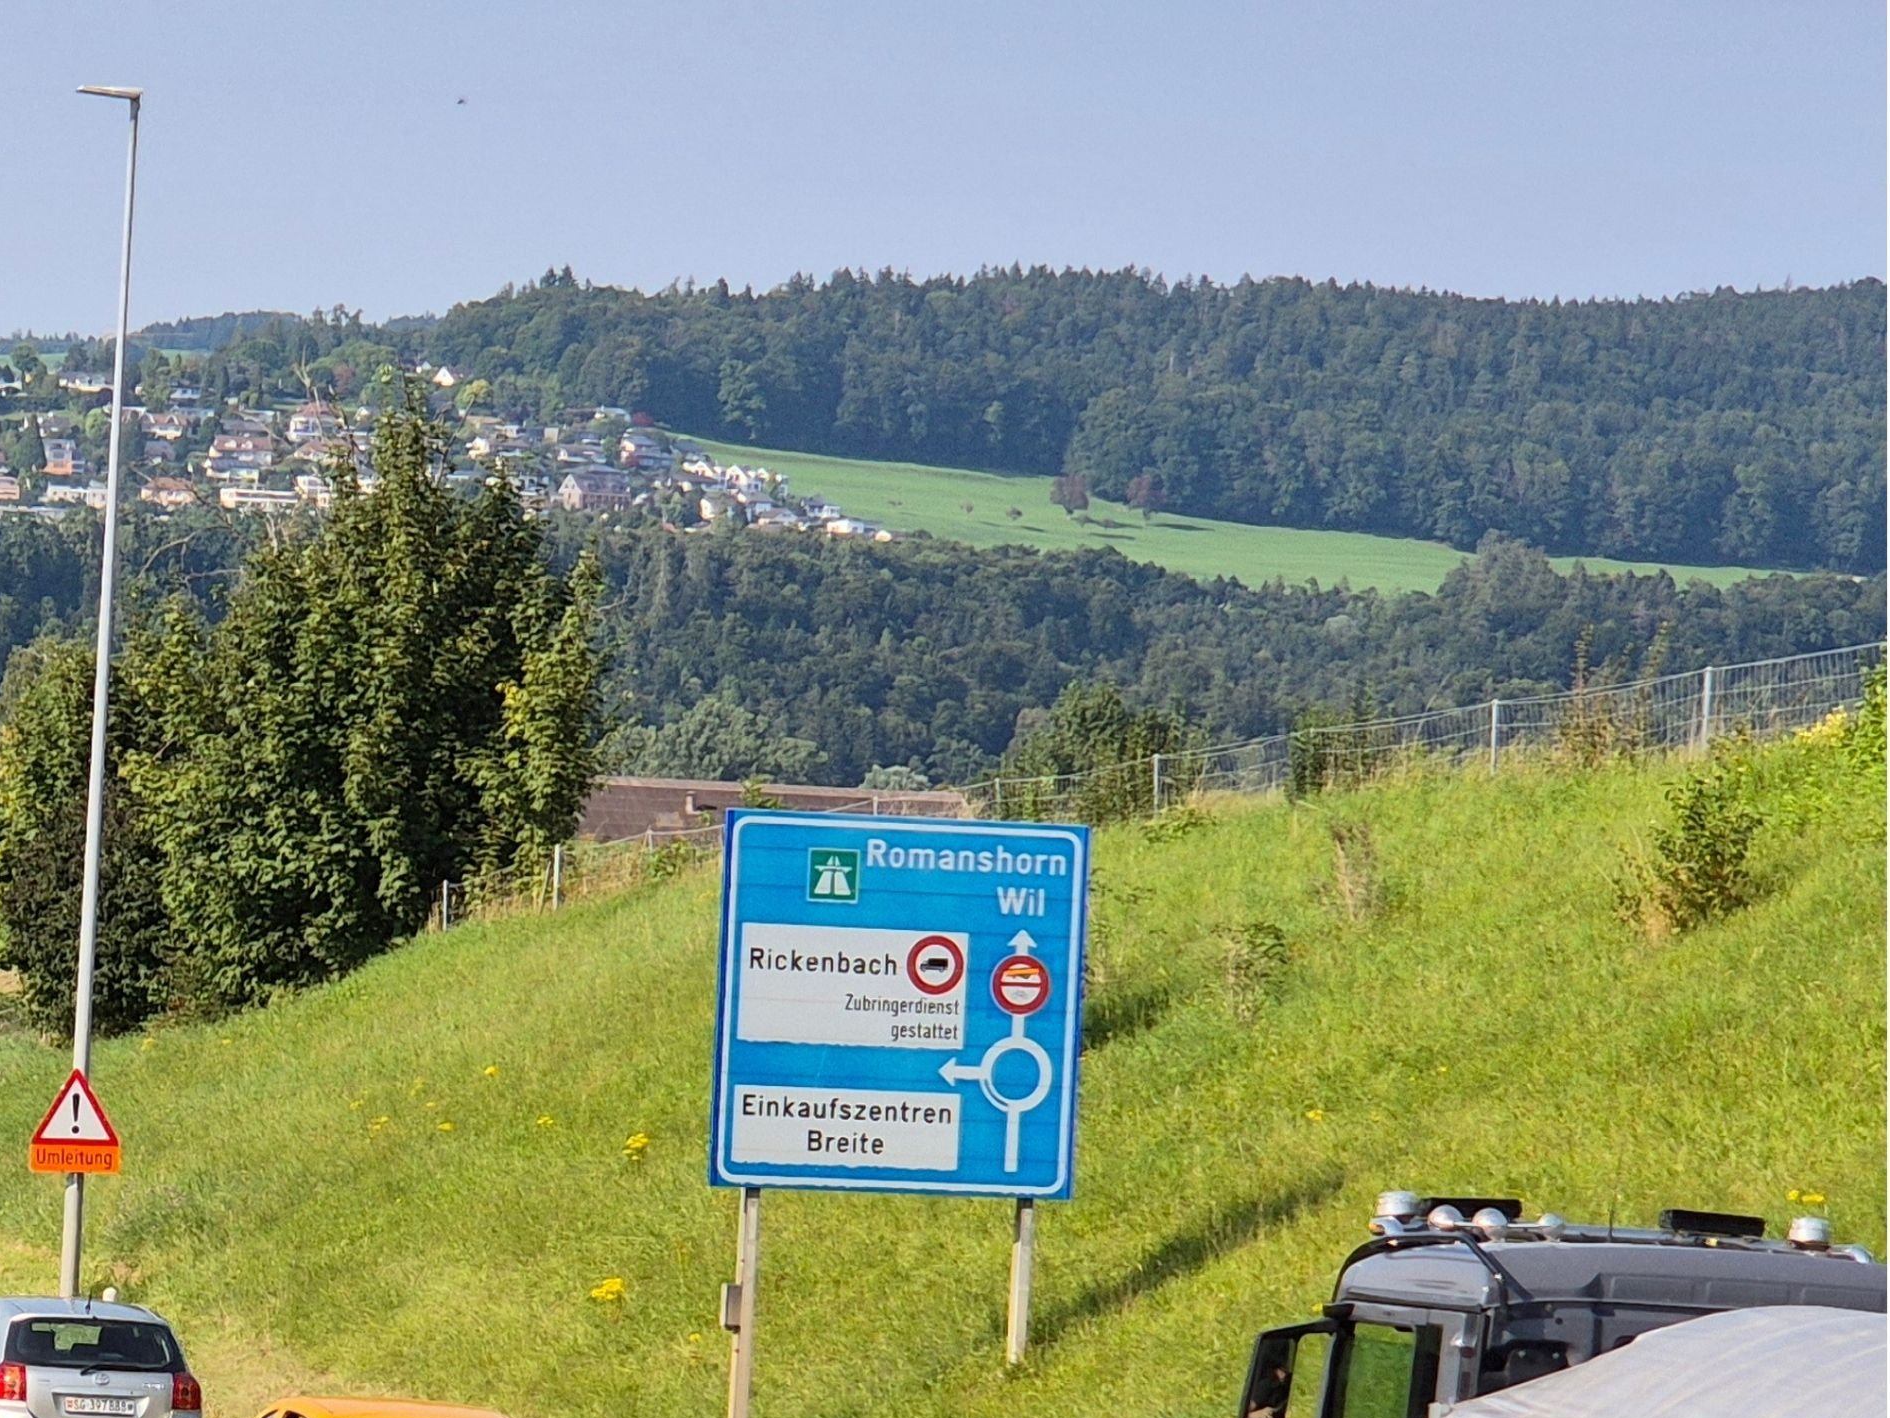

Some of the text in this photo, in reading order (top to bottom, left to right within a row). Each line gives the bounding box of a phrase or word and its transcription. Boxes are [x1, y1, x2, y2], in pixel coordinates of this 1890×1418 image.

[865, 838, 1068, 877] Romanshorn
[996, 886, 1046, 918] Wil
[749, 947, 898, 977] Rickenbach
[844, 994, 960, 1017] Zubringerdienst
[890, 1021, 959, 1042] gestattet
[742, 1094, 953, 1125] Einkaufszentren
[807, 1130, 885, 1155] Breite
[36, 1148, 113, 1170] Umleitung
[73, 1399, 86, 1410] SG
